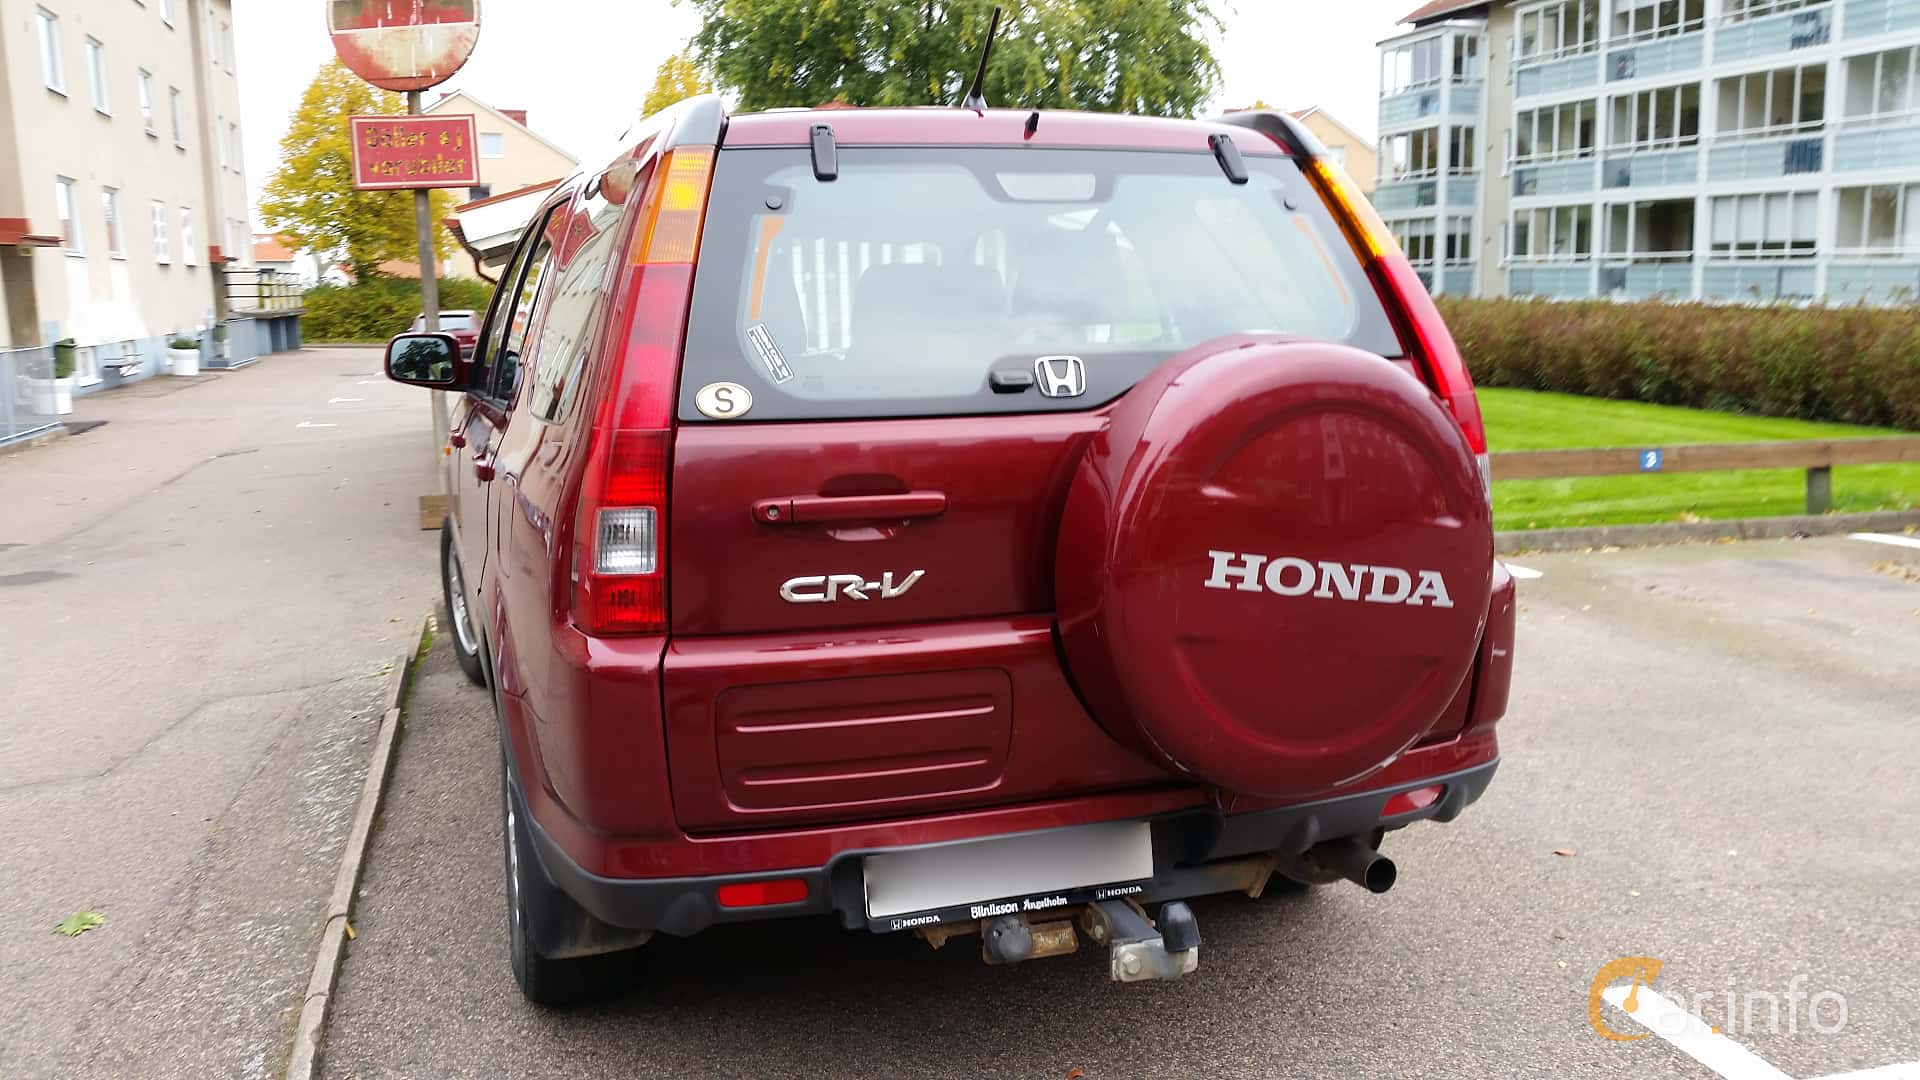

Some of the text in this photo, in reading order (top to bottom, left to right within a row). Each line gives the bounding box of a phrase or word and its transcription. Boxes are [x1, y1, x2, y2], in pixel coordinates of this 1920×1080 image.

[715, 387, 734, 413] S
[780, 569, 925, 602] CR-V
[1204, 550, 1455, 608] HONDA
[1107, 886, 1143, 897] HONDA
[902, 915, 941, 928] HONDA
